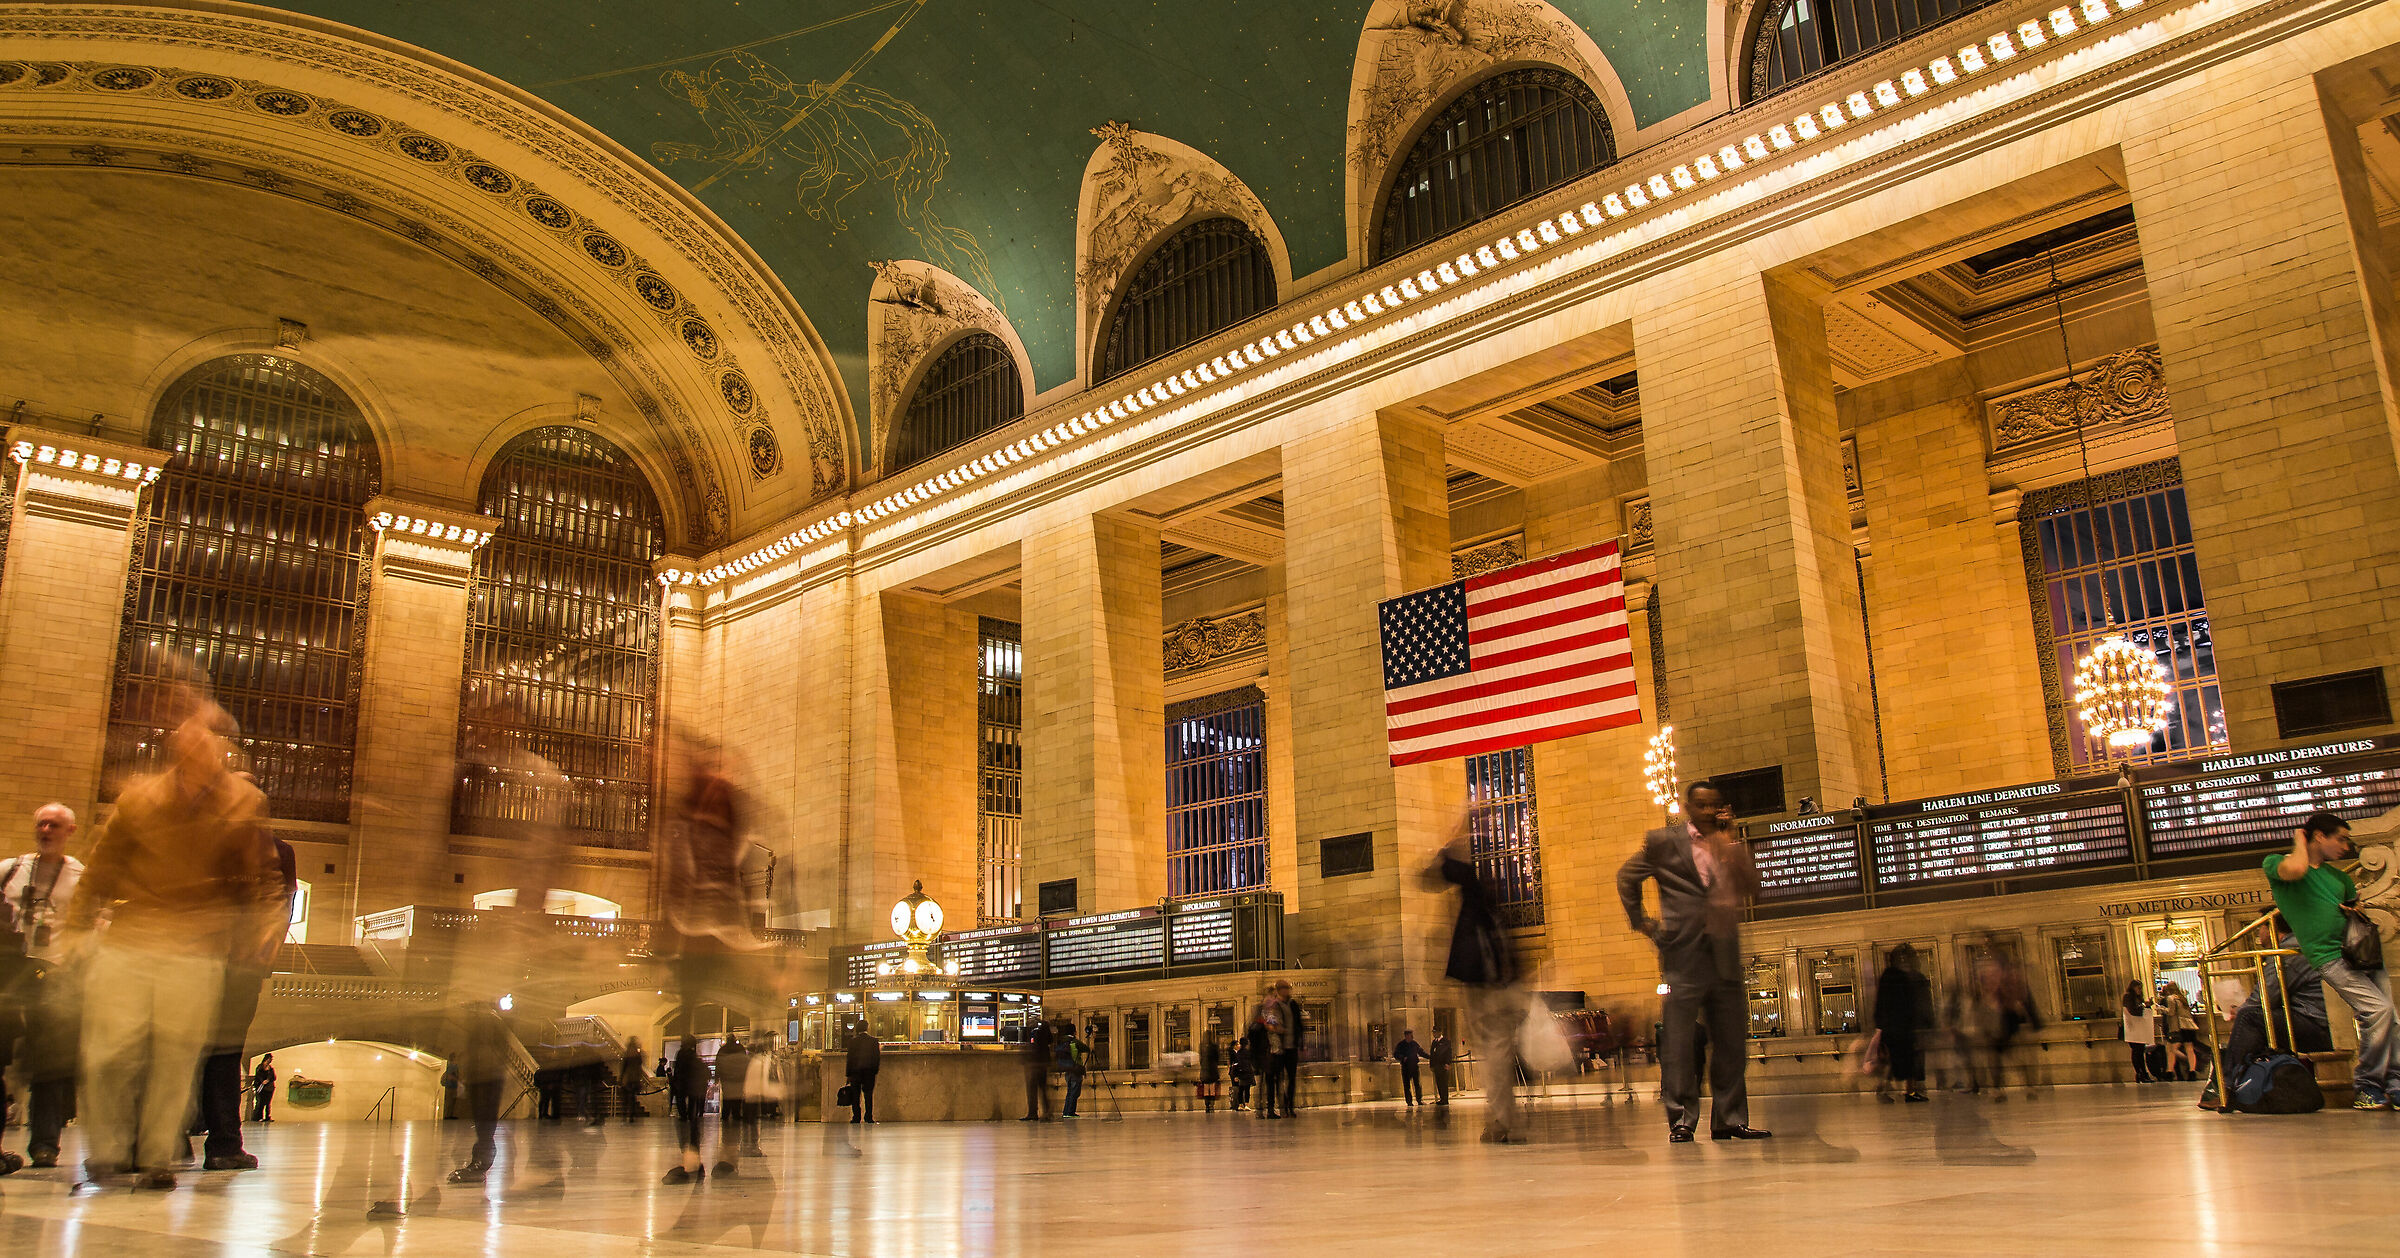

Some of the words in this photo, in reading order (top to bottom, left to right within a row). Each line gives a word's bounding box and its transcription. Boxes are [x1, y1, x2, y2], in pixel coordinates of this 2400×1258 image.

[2202, 756, 2256, 772] HARLEM
[2258, 752, 2288, 764] LINE
[2290, 740, 2375, 760] DEPARTURES
[2143, 787, 2166, 796] TIME
[2171, 783, 2192, 792] TRK
[2196, 774, 2260, 789] DESTINATION
[2273, 766, 2322, 779] REMARKS
[2198, 790, 2238, 801] SOUTHEAST
[2276, 782, 2301, 791] WHITE
[2303, 778, 2332, 788] PLAINS
[2345, 774, 2361, 783] 1ST
[2363, 771, 2385, 780] STOP
[1922, 797, 1966, 811] HARLEM
[1968, 793, 1992, 805] LINE
[1994, 784, 2060, 801] DEPARTURES
[2151, 810, 2168, 819] 1:15
[2213, 802, 2236, 810] WHITE
[2238, 798, 2267, 808] PLAINS
[2324, 788, 2339, 797] 1ST
[2342, 786, 2364, 795] STOP
[2326, 800, 2342, 808] 1ST
[2344, 798, 2367, 807] STOP
[1770, 816, 1835, 832] INFORMATION
[1873, 824, 1892, 833] TIME
[1896, 822, 1913, 830] TRK
[1917, 814, 1969, 827] DESTINATION
[1980, 807, 2018, 818] REMARKS
[1875, 835, 1893, 843] 11:04
[1919, 828, 1950, 838] SOUTHEAST
[1981, 821, 2001, 830] WHITE
[2003, 818, 2027, 827] PLAINS
[2052, 812, 2068, 820] STOP
[1772, 838, 1801, 847] Attention
[1804, 834, 1835, 842] Customers:
[1930, 838, 1948, 847] WHITE
[1951, 835, 1973, 844] PLAINS
[1982, 831, 2010, 840] FORDHAM
[2034, 825, 2050, 833] STOP
[1931, 848, 1950, 857] WHITE
[1952, 845, 1974, 854] PLAINS
[1984, 841, 2011, 851] FORDHAM
[2036, 836, 2052, 844] STOP
[1756, 859, 1787, 868] Unattended
[1831, 851, 1855, 860] removed
[1774, 848, 1789, 857] leave
[1792, 846, 1818, 856] packages
[1820, 841, 1853, 850] unattended
[1922, 859, 1954, 868] SOUTHEAST
[1985, 850, 2024, 860] CONNECTION
[2037, 846, 2057, 855] DOVER
[2060, 843, 2084, 852] PLAINS
[1819, 861, 1852, 871] Department
[1820, 871, 1857, 880] cooperation
[1933, 869, 1952, 878] WHITE
[1955, 866, 1977, 875] PLAINS
[1986, 862, 2014, 871] FORDHAM
[2039, 857, 2055, 865] STOP
[1182, 900, 1220, 912] INFORMATION
[2099, 903, 2133, 917] MTA
[2137, 890, 2262, 914] METRO-NORTH
[1081, 916, 1097, 924] HAVEN
[1110, 911, 1140, 921] DEPARTURES
[996, 927, 1022, 935] DEPARTURES
[600, 977, 652, 992] LEXINGTON
